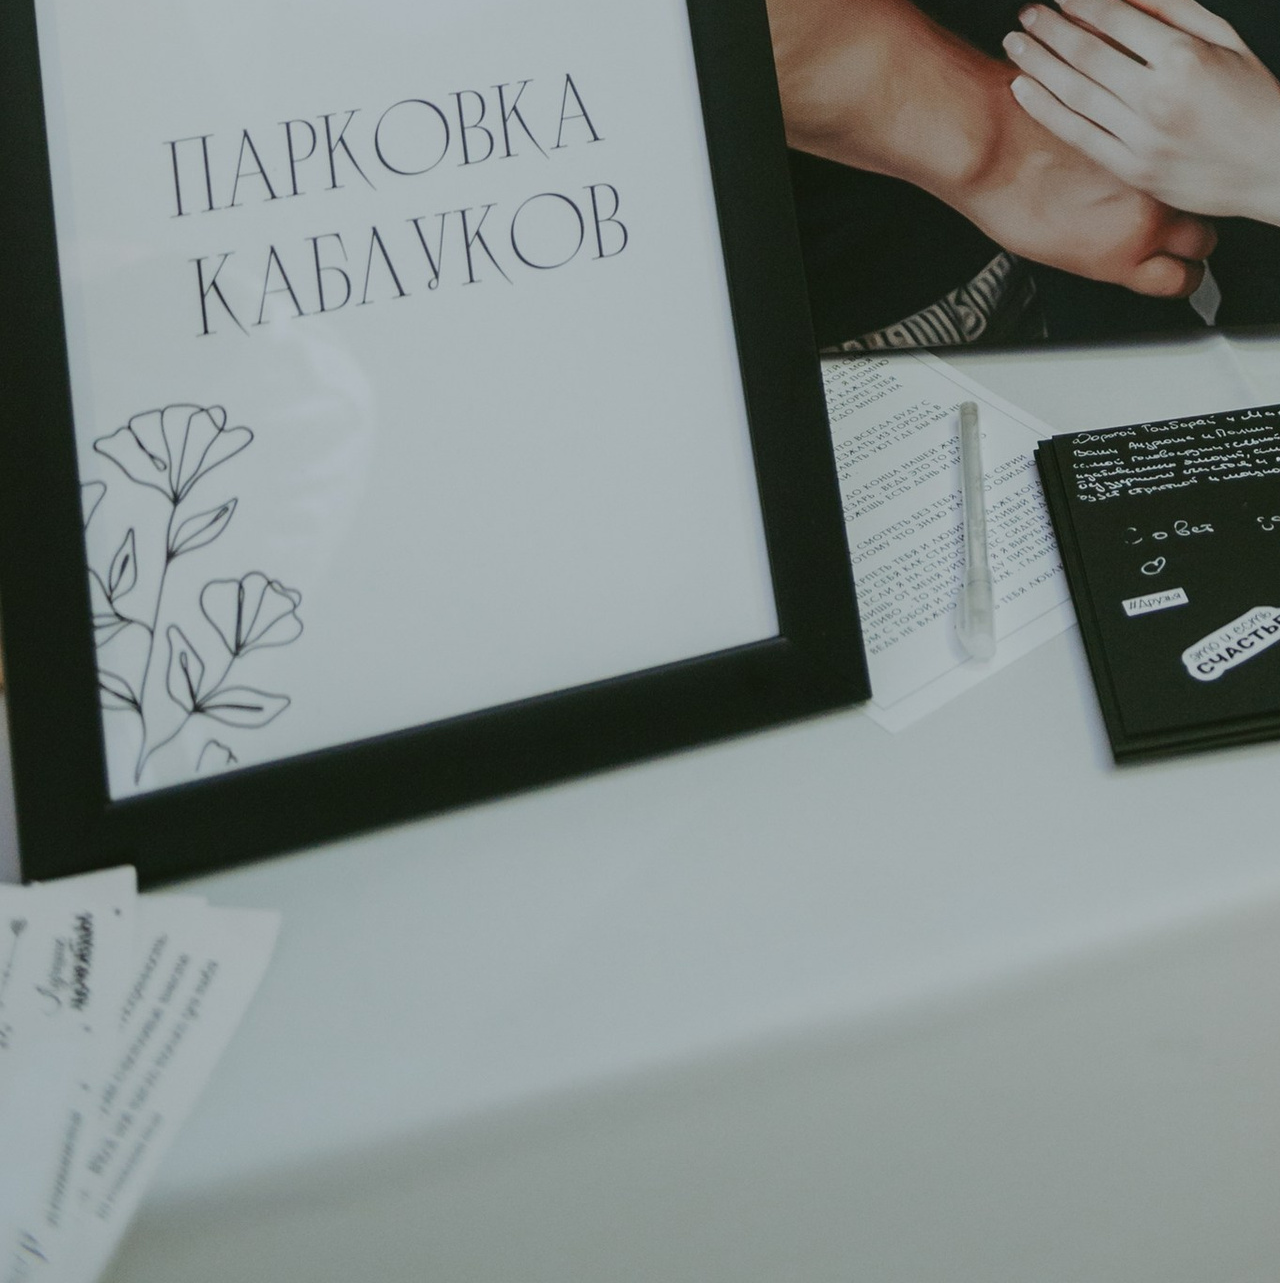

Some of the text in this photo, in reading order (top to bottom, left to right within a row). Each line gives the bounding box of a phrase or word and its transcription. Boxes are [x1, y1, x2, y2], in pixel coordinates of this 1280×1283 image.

[161, 72, 606, 219] ПАРКОВКА
[187, 183, 629, 338] КАБЛУКОВ
[838, 373, 882, 398] КАЖДЫЙ
[851, 359, 890, 382] ПОМНЮ
[872, 376, 897, 390] ТЕБЯ
[856, 384, 903, 409] МНОЙ НА
[855, 399, 931, 441] ВСЕГДА БУДУ С
[870, 411, 949, 454] УЮТ ГДЕ БЫ МЫ
[876, 431, 891, 441] ИЗ
[892, 410, 933, 432] ГОРОДА
[845, 449, 938, 500] ДО КОНЦА НАШЕЙ
[909, 463, 931, 476] ЭТО
[932, 453, 947, 464] ТО
[885, 485, 911, 500] ЕСТЬ
[913, 470, 940, 486] ДЕНЬ
[856, 454, 1027, 549] СМОТРЕТЬ БЕЗ ТЕБЯ СЕРИИ
[892, 528, 915, 541] ЧТО
[915, 511, 947, 529] ЗНАЮ
[863, 587, 894, 607] ЕСЛИ
[905, 572, 922, 583] НА
[997, 516, 1023, 531] ТЕБЕ
[893, 549, 919, 564] ТЕБЯ
[920, 543, 929, 551] И
[894, 514, 1046, 601] ОТ МЕНЯ СИДЕТЬ
[873, 558, 924, 588] СЕБЯ КАК
[893, 603, 932, 627] ТОБОЙ
[1006, 544, 1035, 561] ПИТЬ
[1002, 588, 1027, 606] ТЕБЯ
[1128, 591, 1182, 611] #Друзья
[870, 607, 901, 628] ПИВО
[870, 637, 899, 655] ВЕДЬ
[900, 627, 914, 637] НЕ
[916, 602, 957, 627] ВАЖНО
[1188, 640, 1221, 663] это
[1233, 609, 1272, 635] есть
